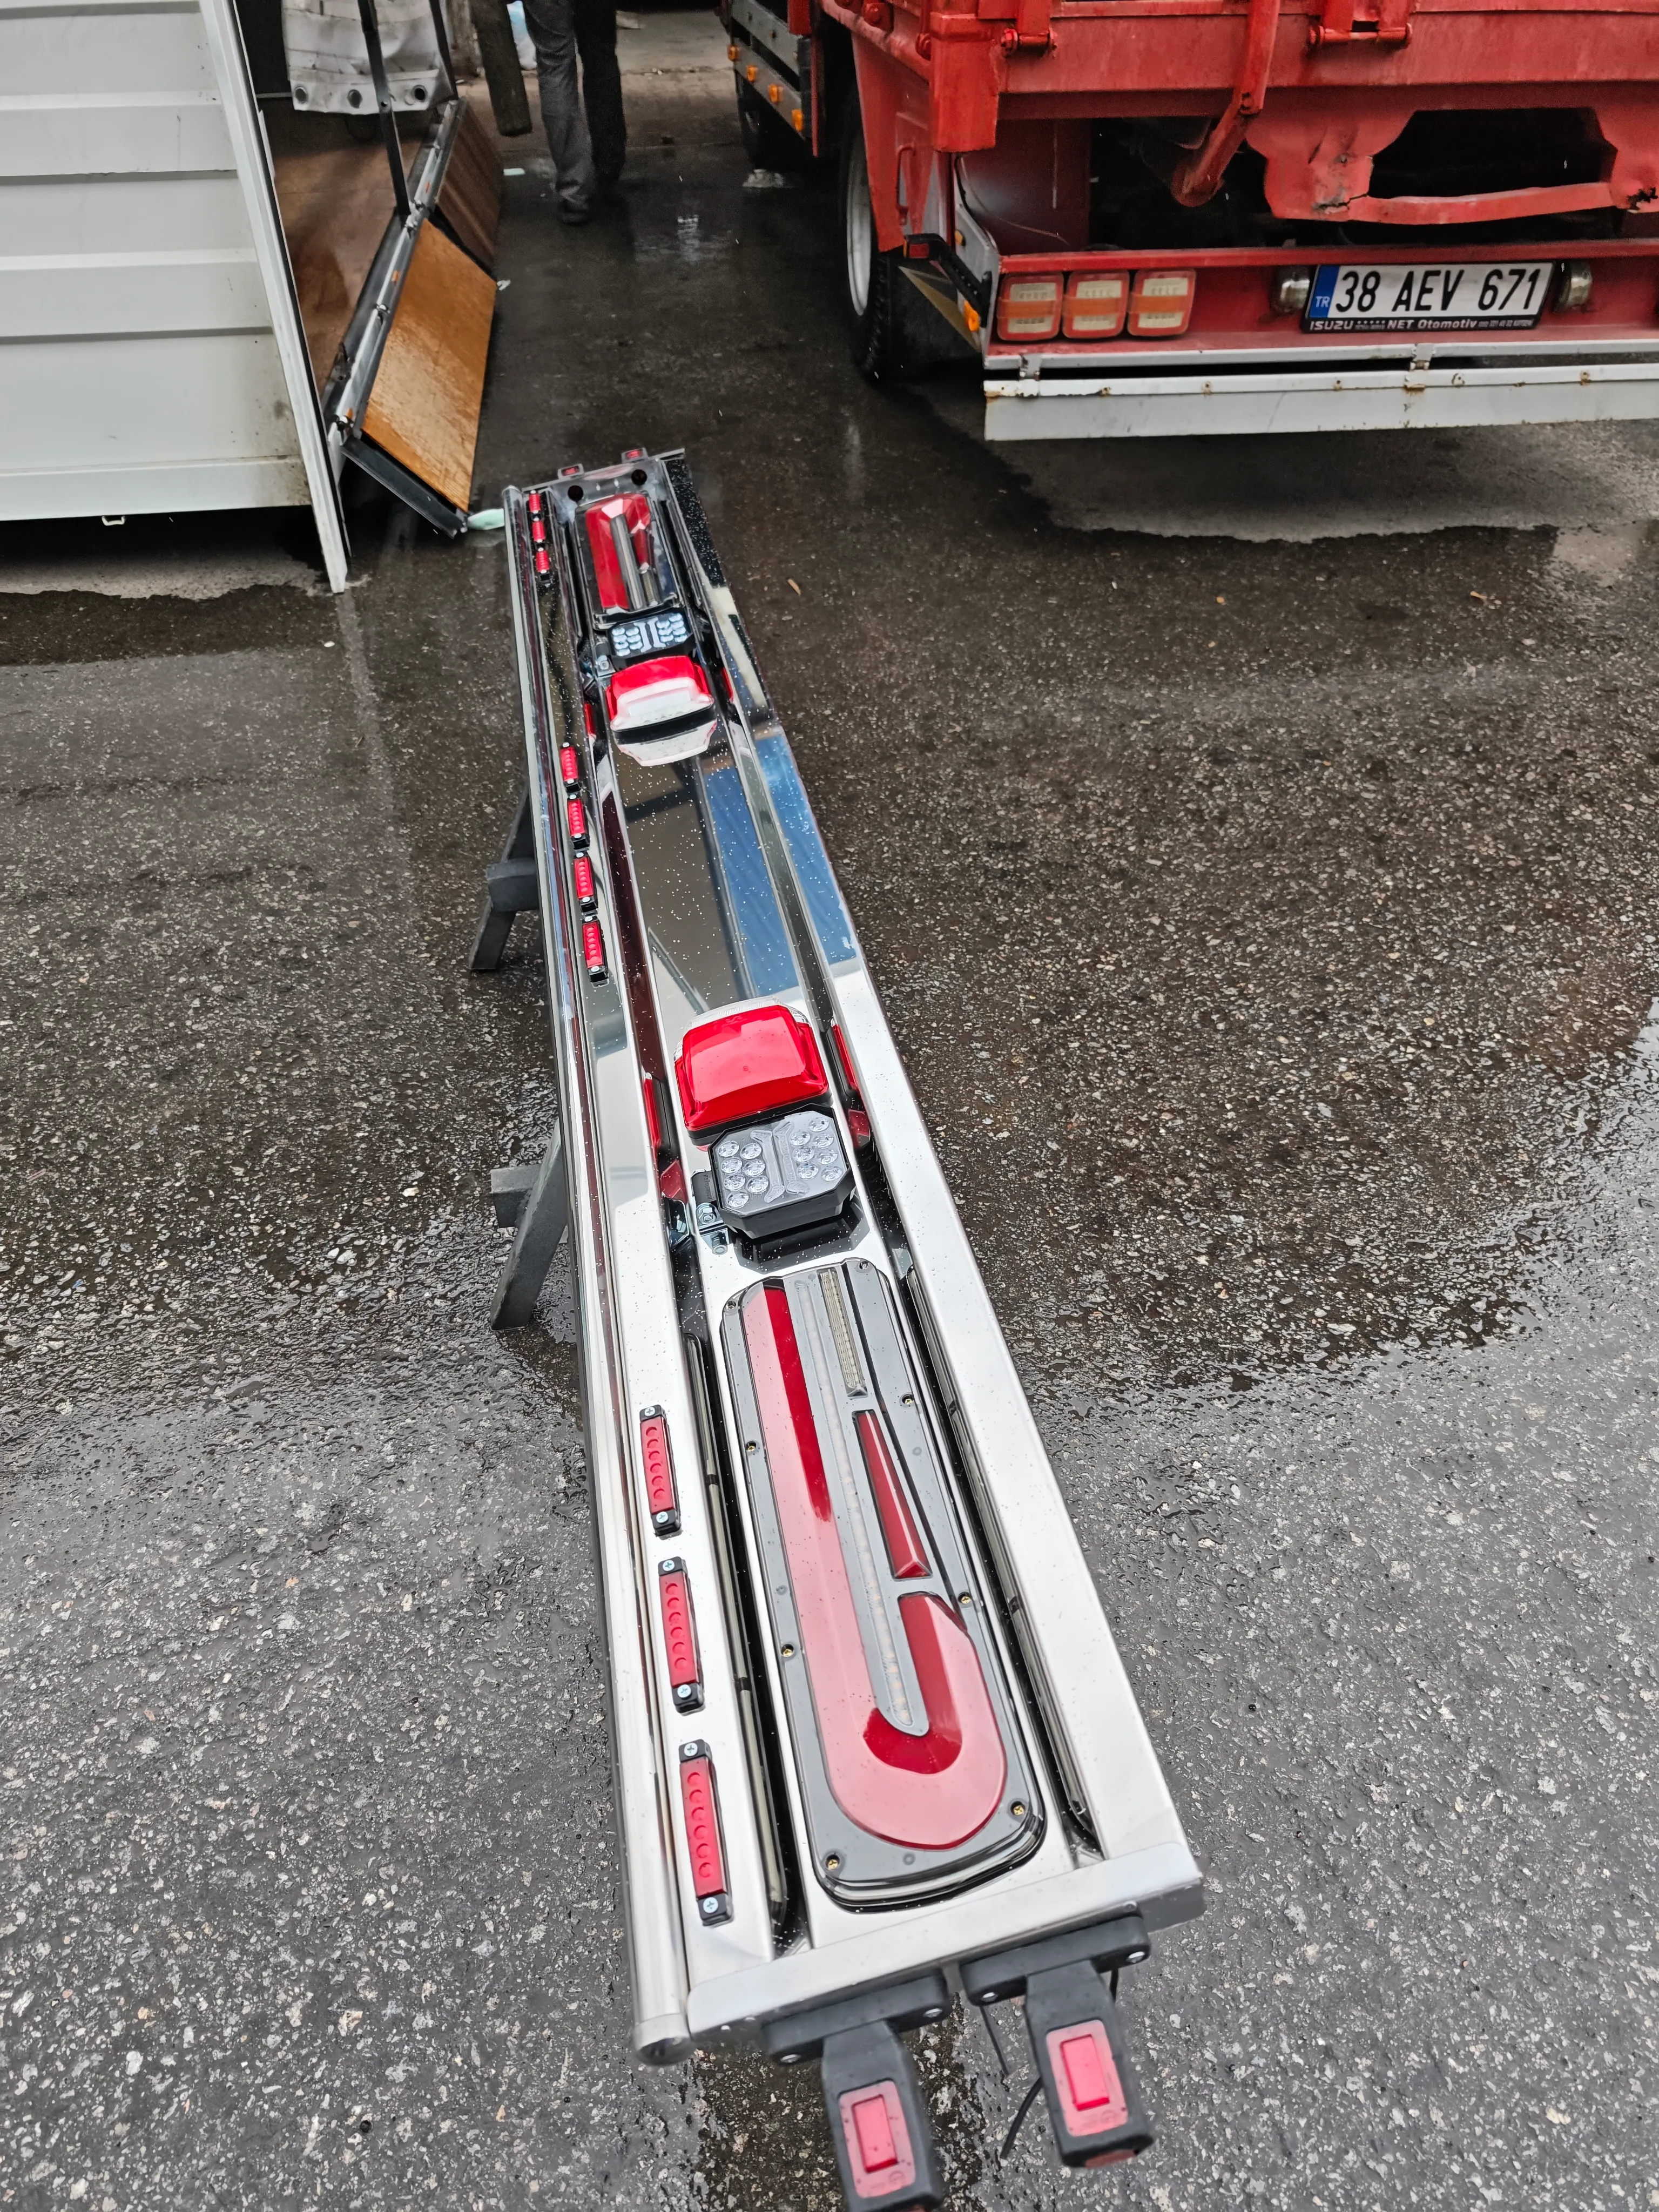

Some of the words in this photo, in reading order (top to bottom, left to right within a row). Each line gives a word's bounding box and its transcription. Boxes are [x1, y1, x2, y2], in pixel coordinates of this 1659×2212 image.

[1336, 271, 1381, 312] 38
[1392, 269, 1464, 312] AEV
[1478, 268, 1541, 311] 671
[1316, 295, 1330, 307] TR
[1310, 320, 1354, 331] ISUZU
[1387, 319, 1415, 329] NET
[1417, 319, 1478, 329] Otomotiv
